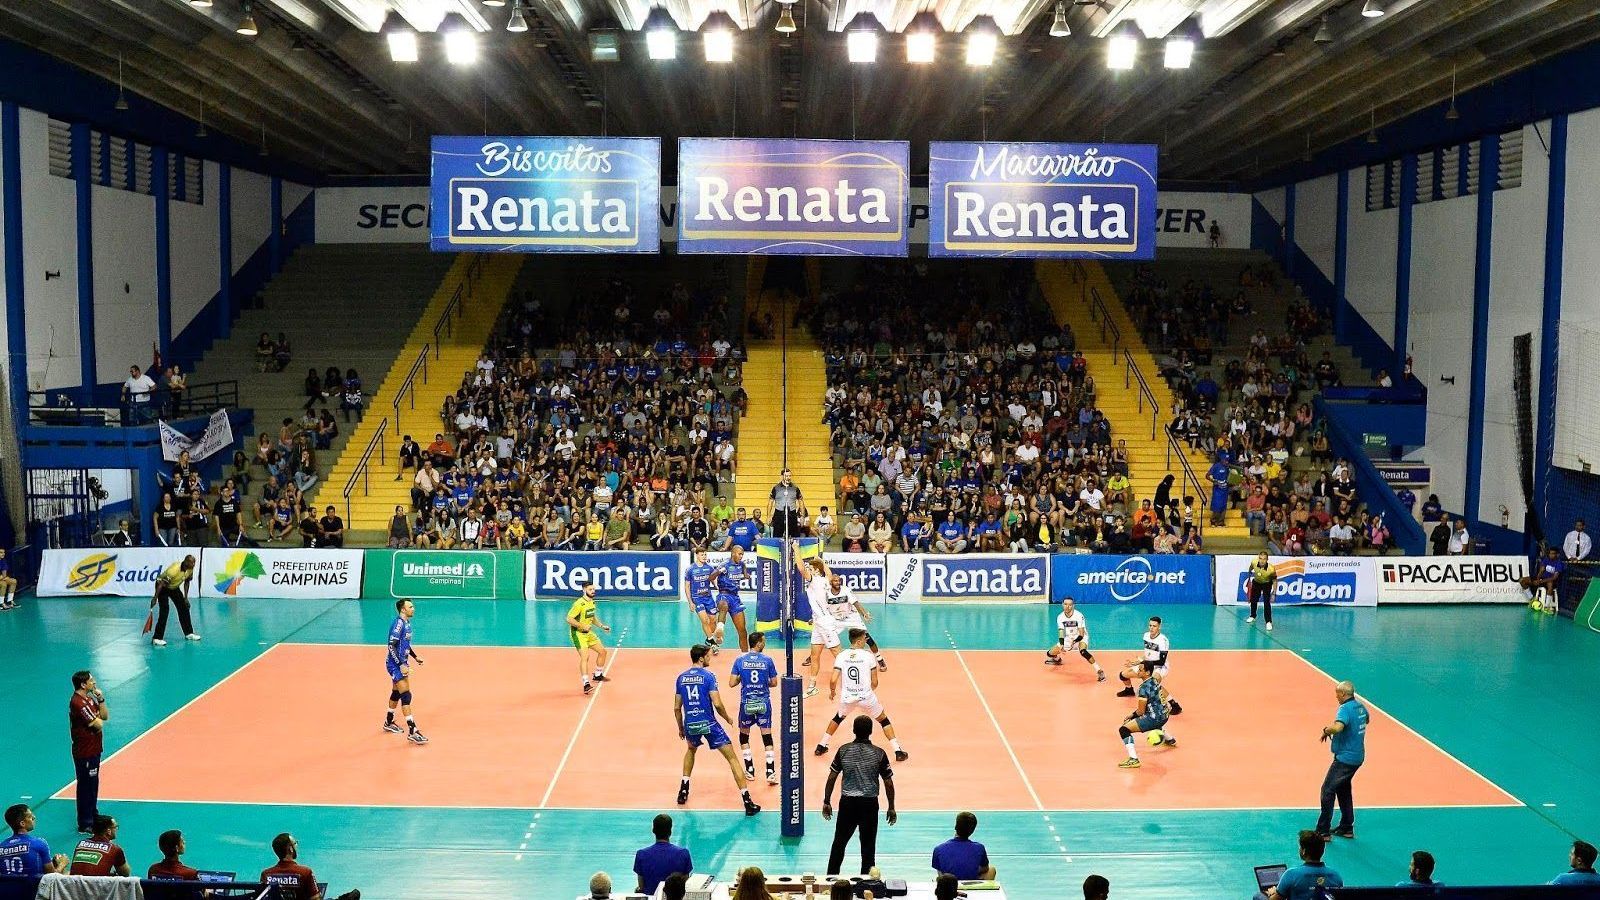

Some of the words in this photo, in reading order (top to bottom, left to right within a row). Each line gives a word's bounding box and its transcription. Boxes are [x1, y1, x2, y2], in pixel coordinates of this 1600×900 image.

[475, 141, 612, 177] Biscoitos
[970, 146, 1121, 180] Macarrão
[694, 176, 890, 223] Renata
[357, 203, 431, 228] SEC
[457, 187, 630, 233] Renata
[953, 191, 1129, 239] Renata
[116, 564, 163, 582] saúd
[272, 561, 334, 571] PREFEITURA
[336, 560, 350, 570] DE
[403, 562, 462, 575] Unimed
[1309, 561, 1361, 569] Supermercados
[1398, 564, 1523, 583] PACAEMBU
[271, 572, 348, 585] CAMPINAS
[430, 577, 462, 585] Campinas
[542, 559, 673, 591] Renata
[762, 561, 771, 593] Renata
[840, 571, 880, 590] nata
[888, 557, 918, 600] Massas
[926, 563, 1042, 593] Renata
[750, 670, 759, 683] 8
[847, 666, 860, 685] 9
[686, 685, 699, 700] 14
[790, 695, 799, 733] Renata
[790, 742, 799, 779] Renata
[791, 788, 800, 825] Renata
[0, 844, 27, 855] Renata
[78, 840, 109, 851] Renata
[4, 856, 23, 874] 10
